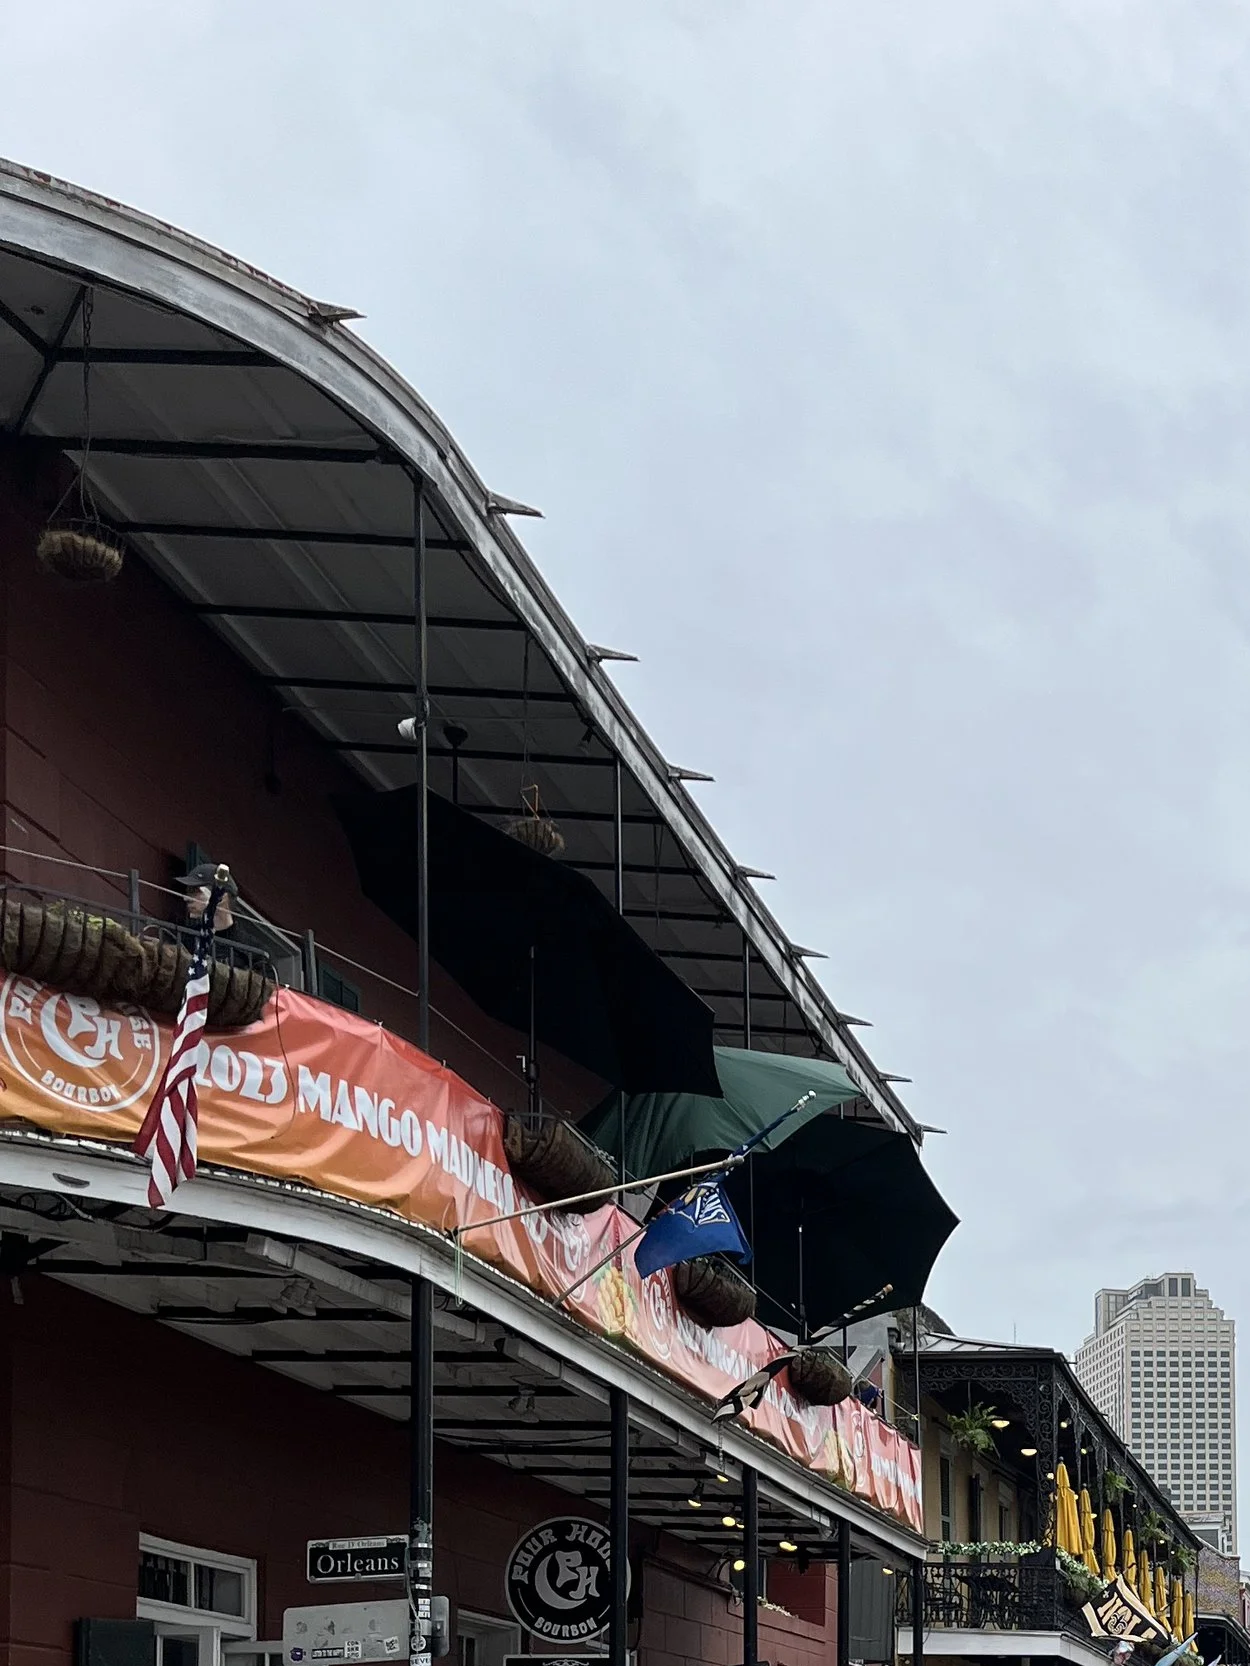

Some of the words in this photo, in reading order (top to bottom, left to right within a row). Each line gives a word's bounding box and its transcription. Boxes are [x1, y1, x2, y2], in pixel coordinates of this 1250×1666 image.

[41, 1069, 122, 1104] BOURBON
[193, 1037, 288, 1104] 2023
[298, 1064, 423, 1158] MANGO
[425, 1119, 516, 1219] MADNESS
[316, 1552, 400, 1575] Orleans
[511, 1528, 558, 1585] POUR
[565, 1522, 611, 1572] HOU
[534, 1616, 598, 1637] BOURBON
